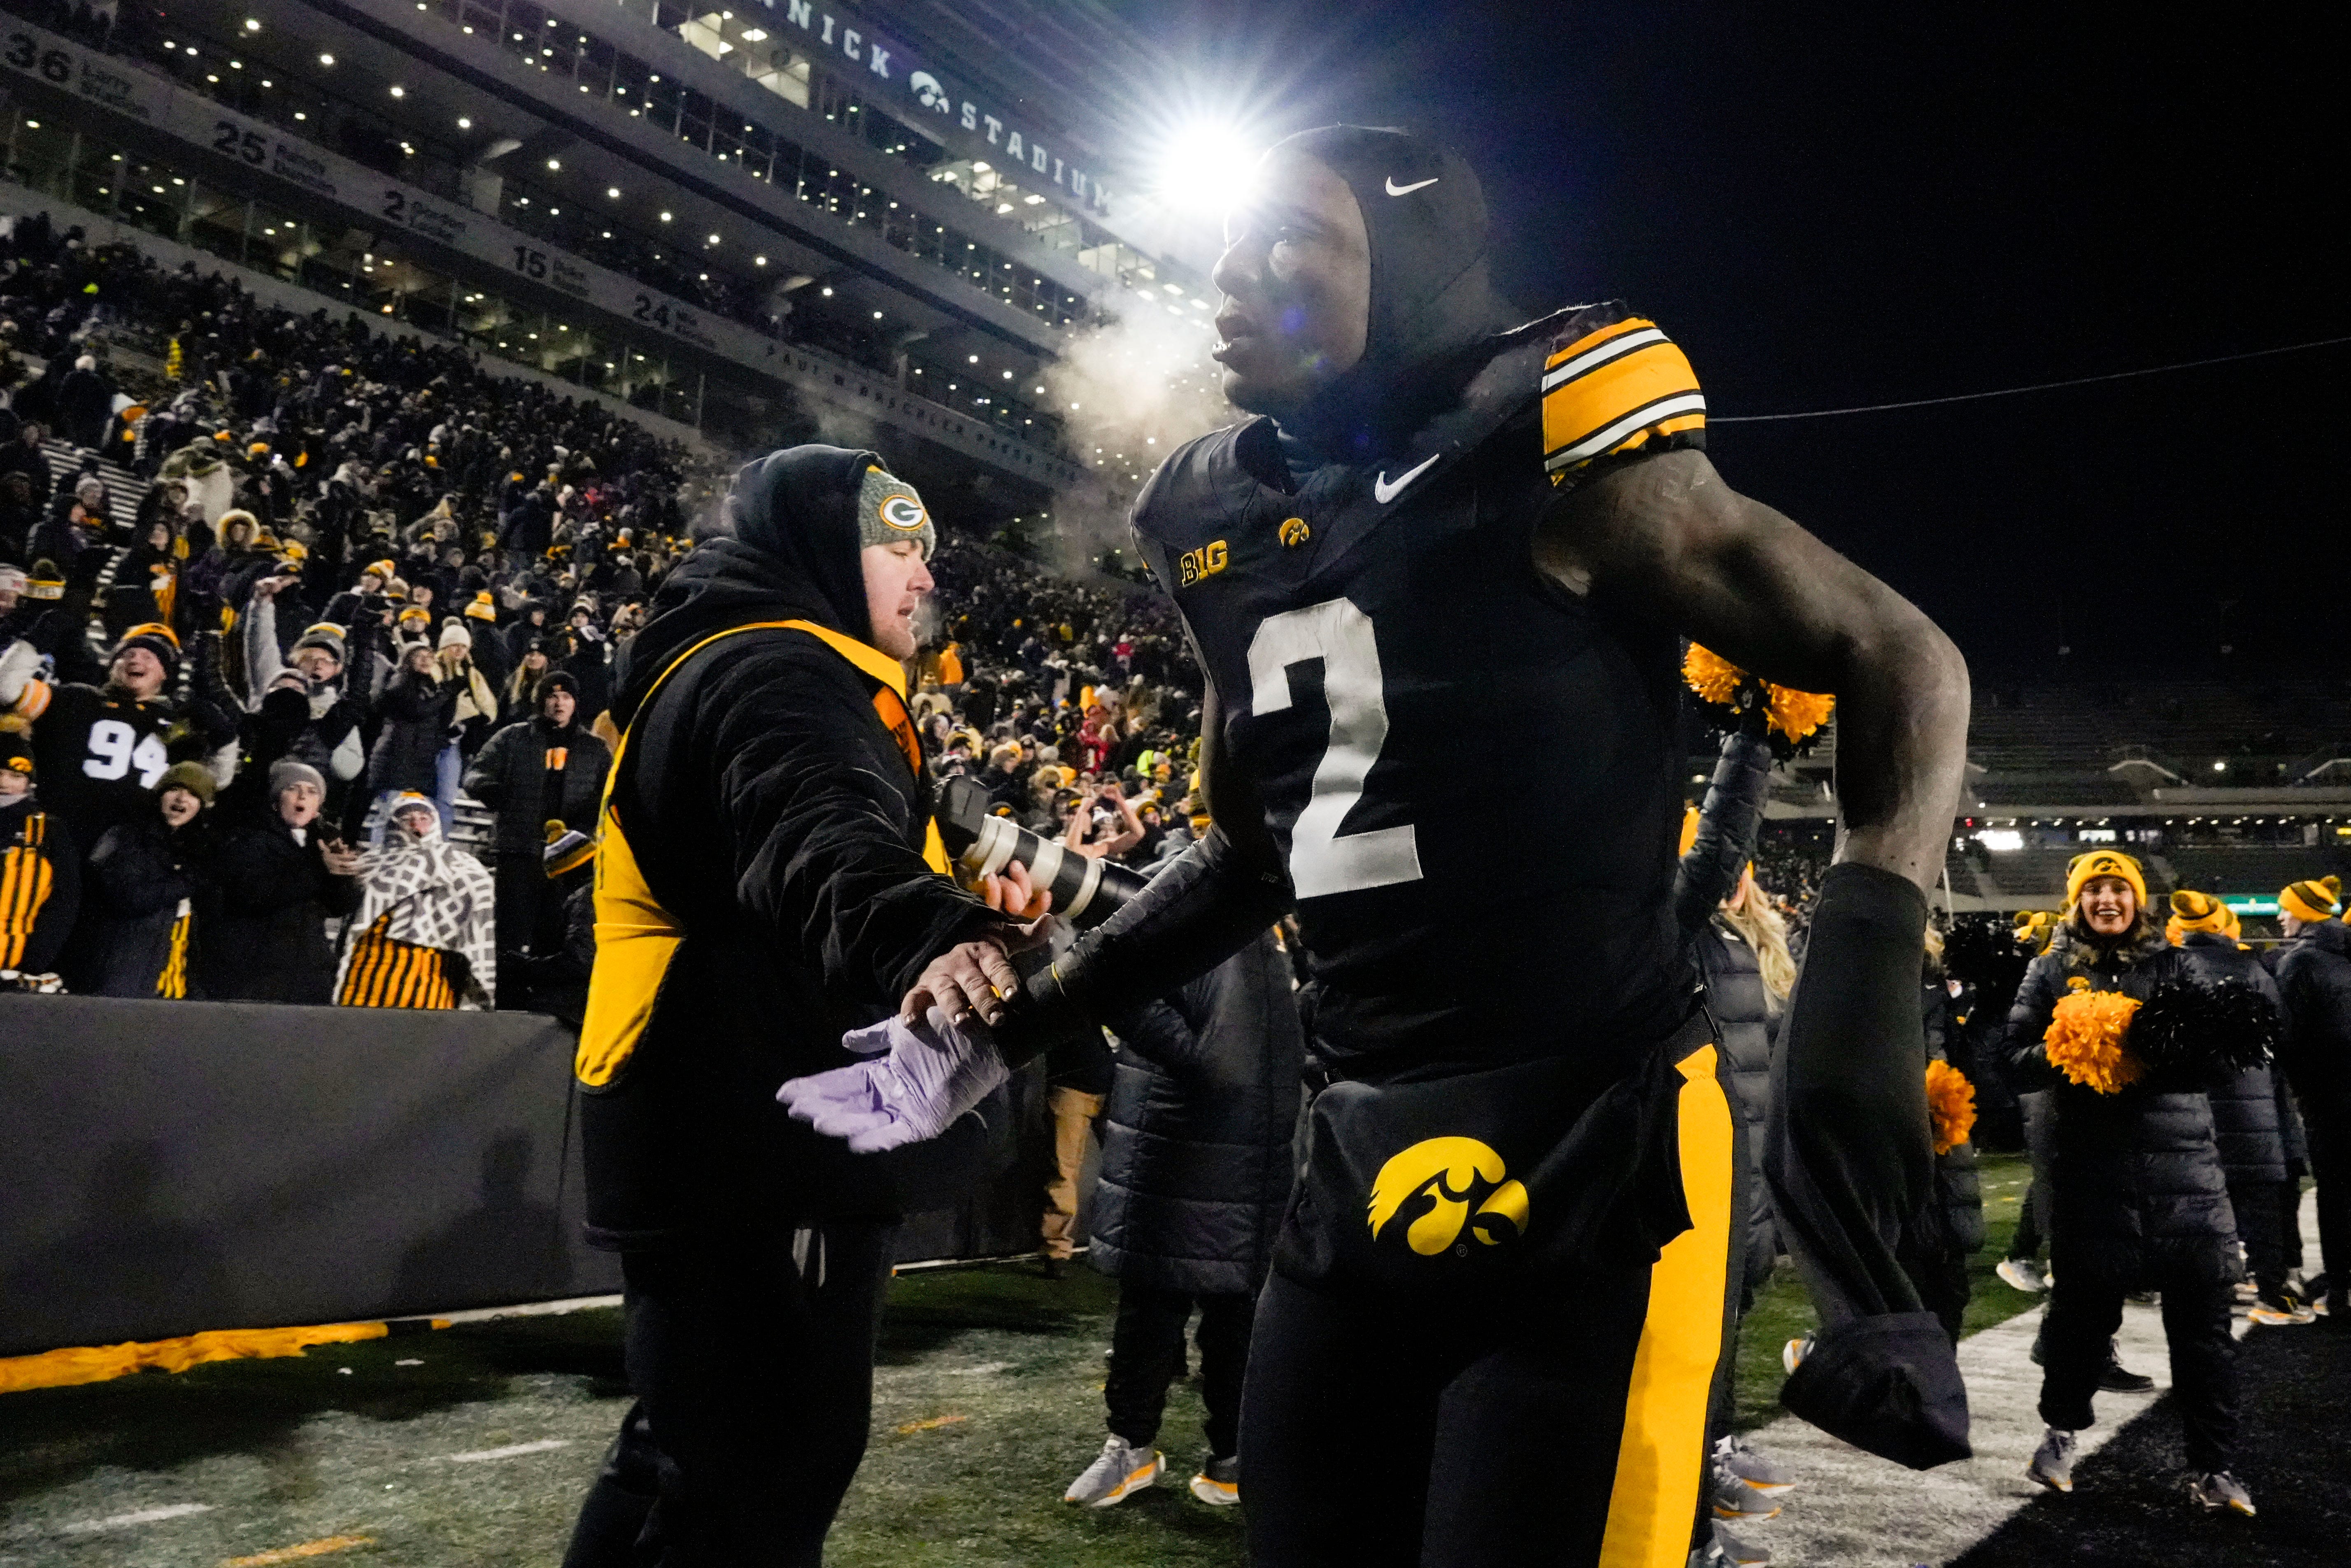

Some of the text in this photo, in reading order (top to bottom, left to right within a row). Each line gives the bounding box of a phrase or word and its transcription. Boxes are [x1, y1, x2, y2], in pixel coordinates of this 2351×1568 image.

[6, 33, 71, 81] 36
[214, 121, 266, 163] 25
[961, 100, 1113, 212] STADIUM
[383, 191, 405, 221] 2
[513, 246, 547, 279] 15
[633, 294, 670, 328] 24
[880, 496, 926, 529] G
[82, 719, 170, 789] 94
[1248, 597, 1424, 900] 2
